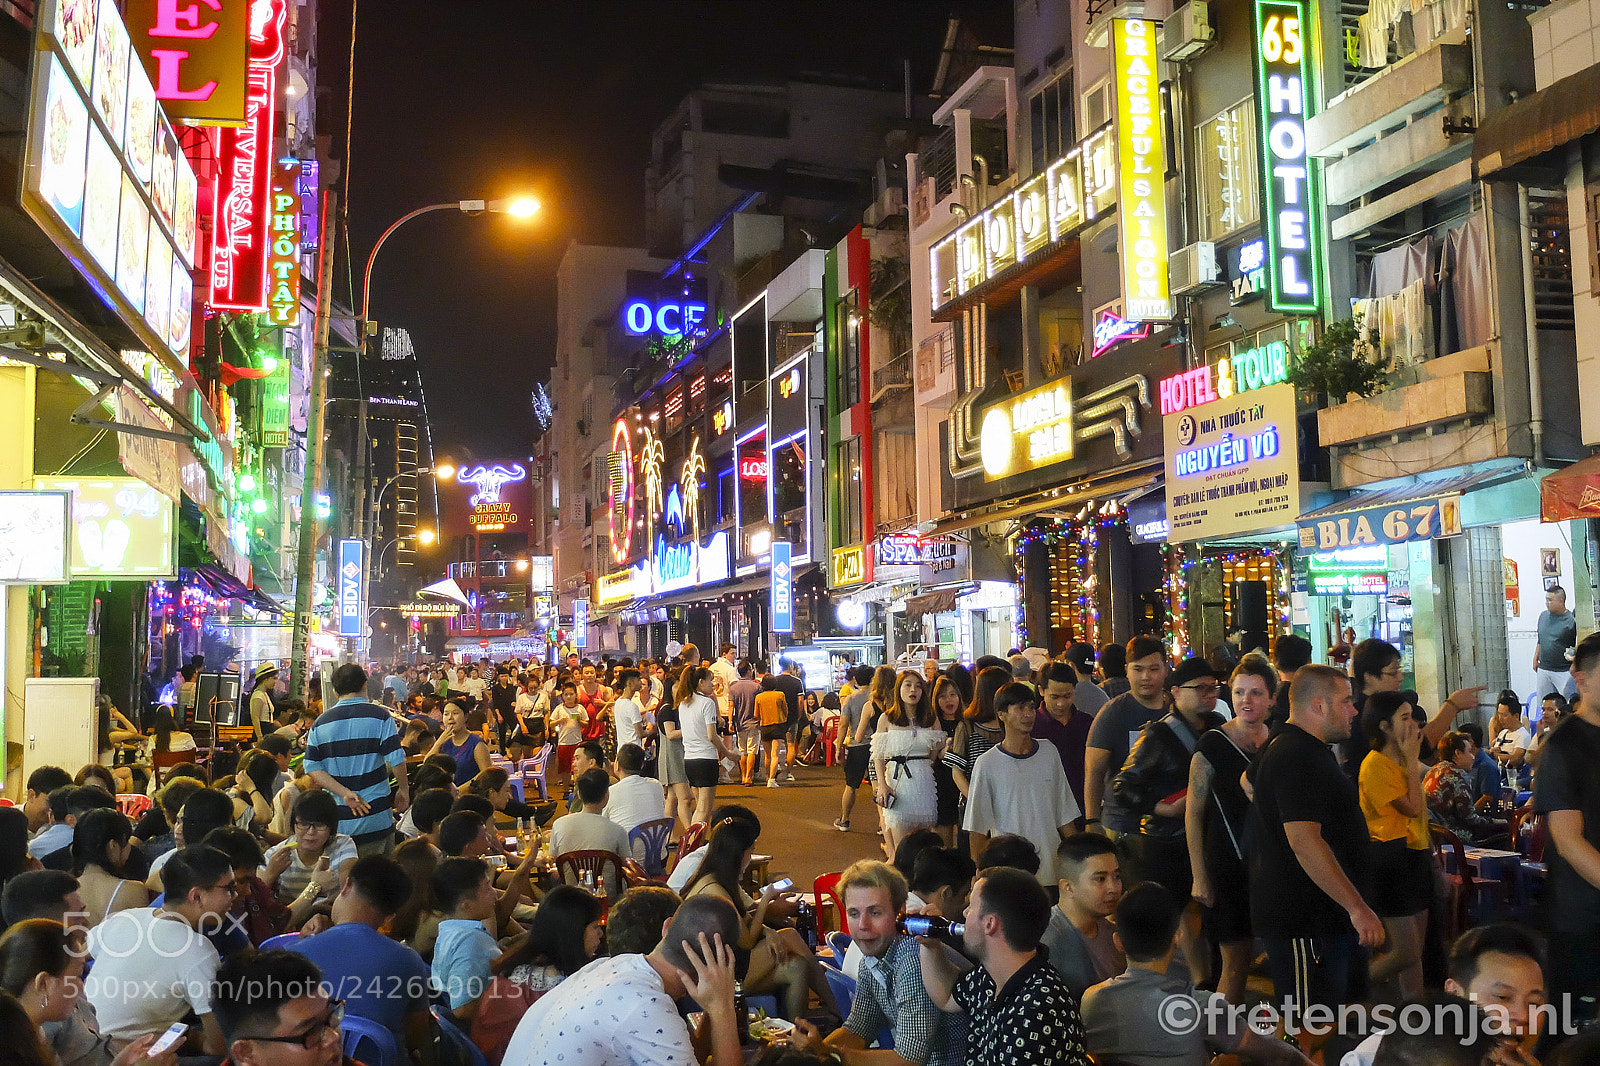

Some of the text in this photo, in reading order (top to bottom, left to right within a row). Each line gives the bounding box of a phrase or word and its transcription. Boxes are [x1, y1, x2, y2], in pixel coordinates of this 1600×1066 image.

[1263, 17, 1300, 64] 65
[1124, 19, 1159, 297] GRACEFUL SAIGON
[1268, 75, 1309, 295] HOTEL
[214, 245, 229, 289] PUB
[271, 261, 295, 322] TÂY
[1129, 301, 1169, 318] HOTEL
[1160, 366, 1217, 416] HOTEL
[1216, 358, 1234, 400] &
[1231, 341, 1291, 394] TOUR
[265, 433, 286, 444] HOTEL
[1200, 415, 1217, 435] NHÀ
[1219, 407, 1246, 429] THUỐC
[1175, 432, 1248, 477] NGUYỄN
[114, 489, 160, 519] 94
[469, 513, 518, 524] BUFFALO
[475, 502, 511, 513] CRAZY
[1317, 515, 1377, 550] BIA
[1382, 504, 1438, 541] 67
[882, 536, 919, 563] SPA
[343, 579, 358, 617] BIDV
[776, 577, 789, 613] BIDV
[1360, 576, 1385, 585] HOTEL
